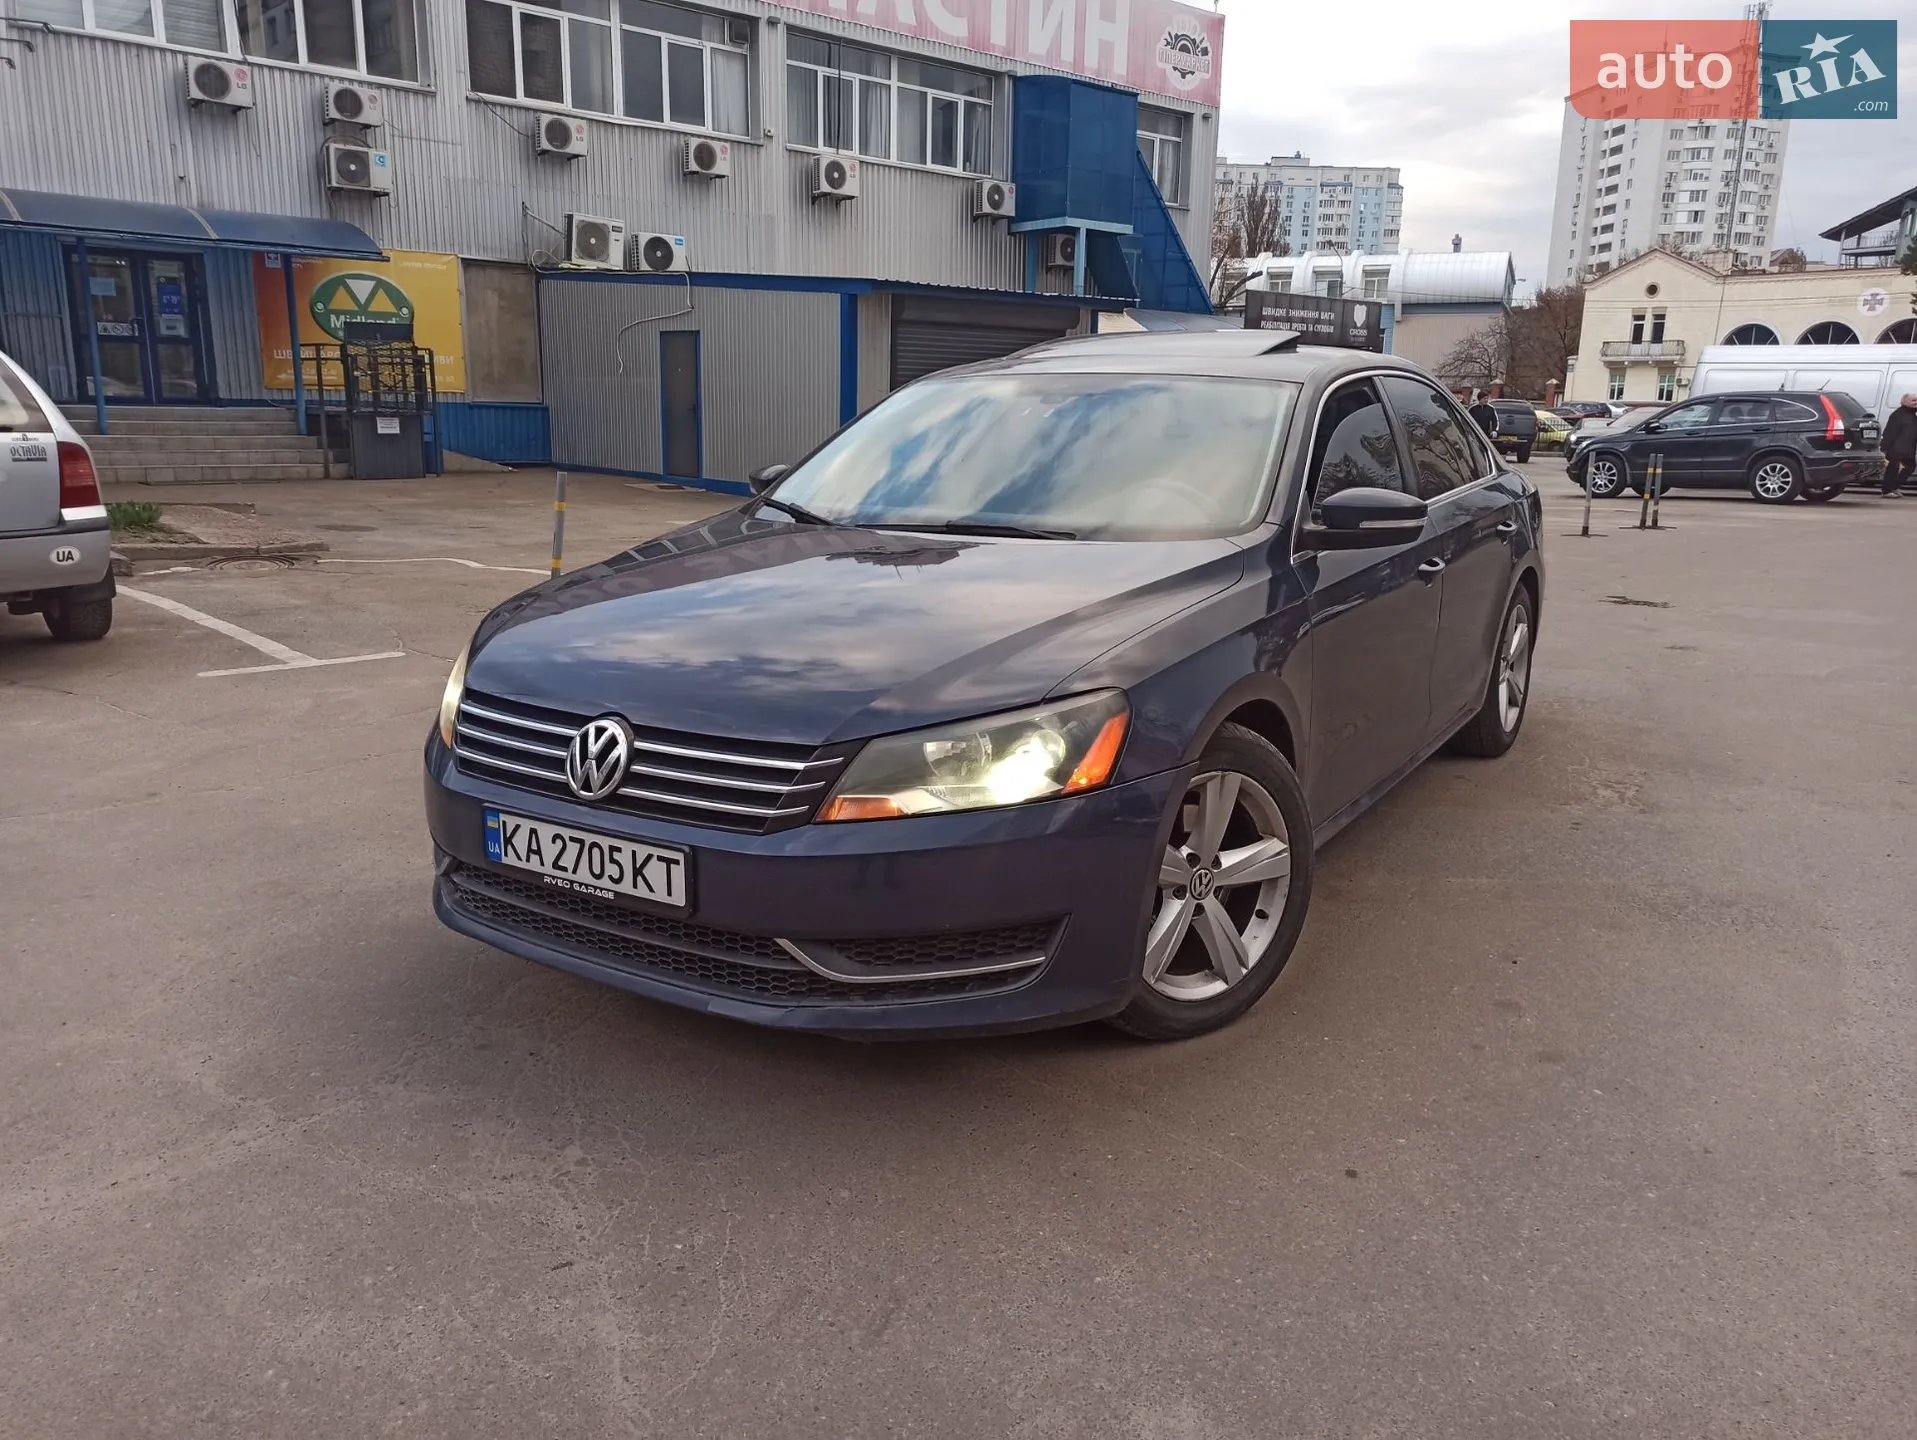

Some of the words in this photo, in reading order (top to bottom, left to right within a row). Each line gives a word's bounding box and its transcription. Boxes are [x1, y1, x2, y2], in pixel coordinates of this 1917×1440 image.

[236, 82, 247, 90] LG
[1262, 307, 1287, 317] ШВИДКЕ
[1288, 308, 1319, 319] ЗНИЖЕННЯ
[1320, 311, 1335, 320] ВАГИ
[56, 550, 75, 563] UA
[488, 841, 500, 854] UA
[502, 819, 545, 867] KA
[551, 832, 625, 885] 2705
[631, 849, 681, 897] KT
[573, 883, 615, 899] GARAGE
